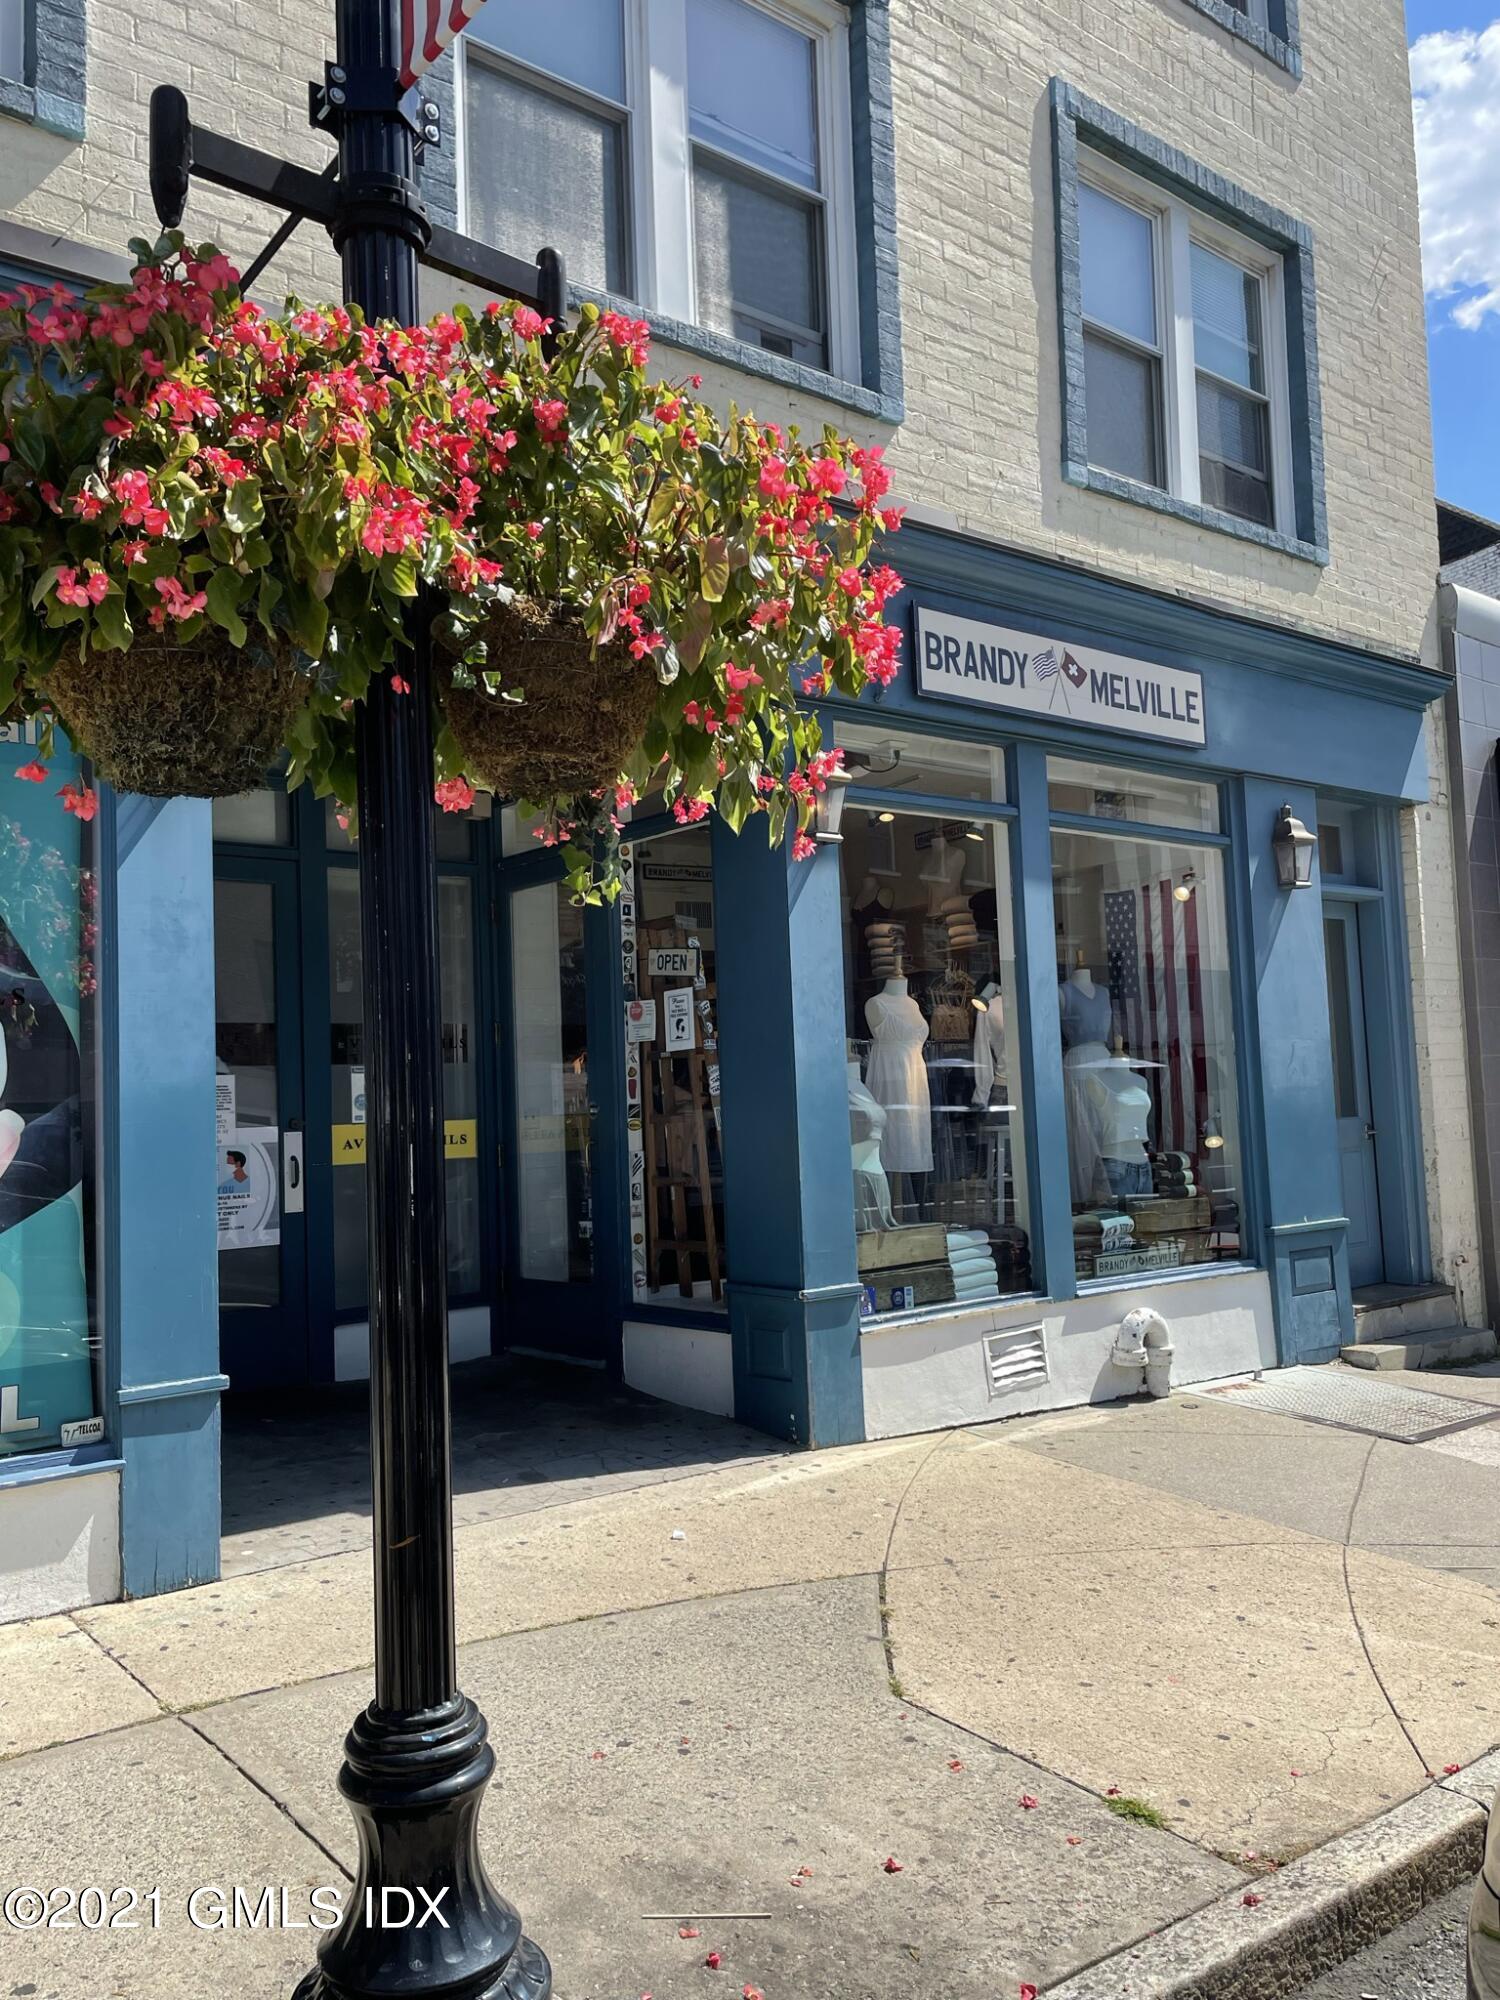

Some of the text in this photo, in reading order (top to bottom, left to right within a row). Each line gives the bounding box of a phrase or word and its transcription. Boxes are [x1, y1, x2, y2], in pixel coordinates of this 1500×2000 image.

[924, 630, 1200, 725] BRANDY MELVILLE
[656, 954, 688, 972] OPEN
[1099, 1251, 1178, 1273] BRANDY MELVILLE
